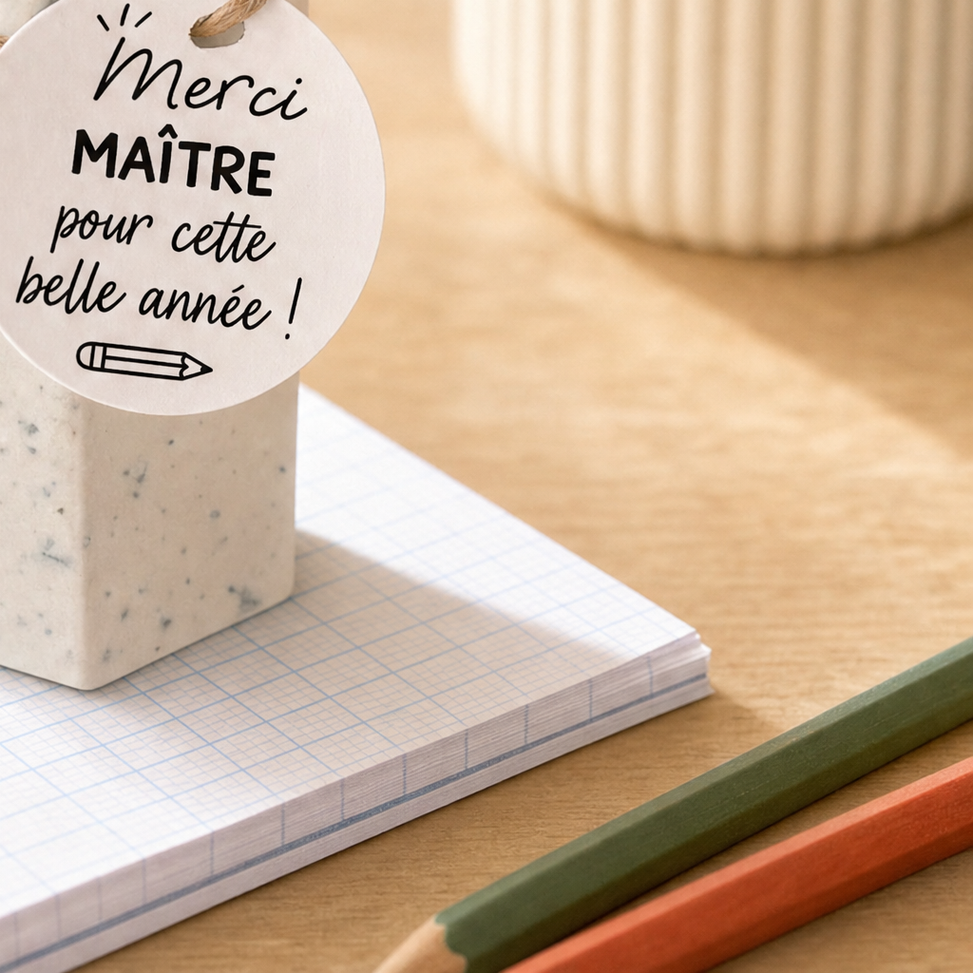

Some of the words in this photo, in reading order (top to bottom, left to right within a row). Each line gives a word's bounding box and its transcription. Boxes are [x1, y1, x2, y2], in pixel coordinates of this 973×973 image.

[92, 36, 308, 121] Merci
[71, 123, 276, 197] MAÎTRE
[49, 205, 154, 254] pour
[171, 211, 277, 264] cette
[15, 255, 127, 315] belle
[138, 284, 272, 331] année
[284, 277, 303, 340] !
